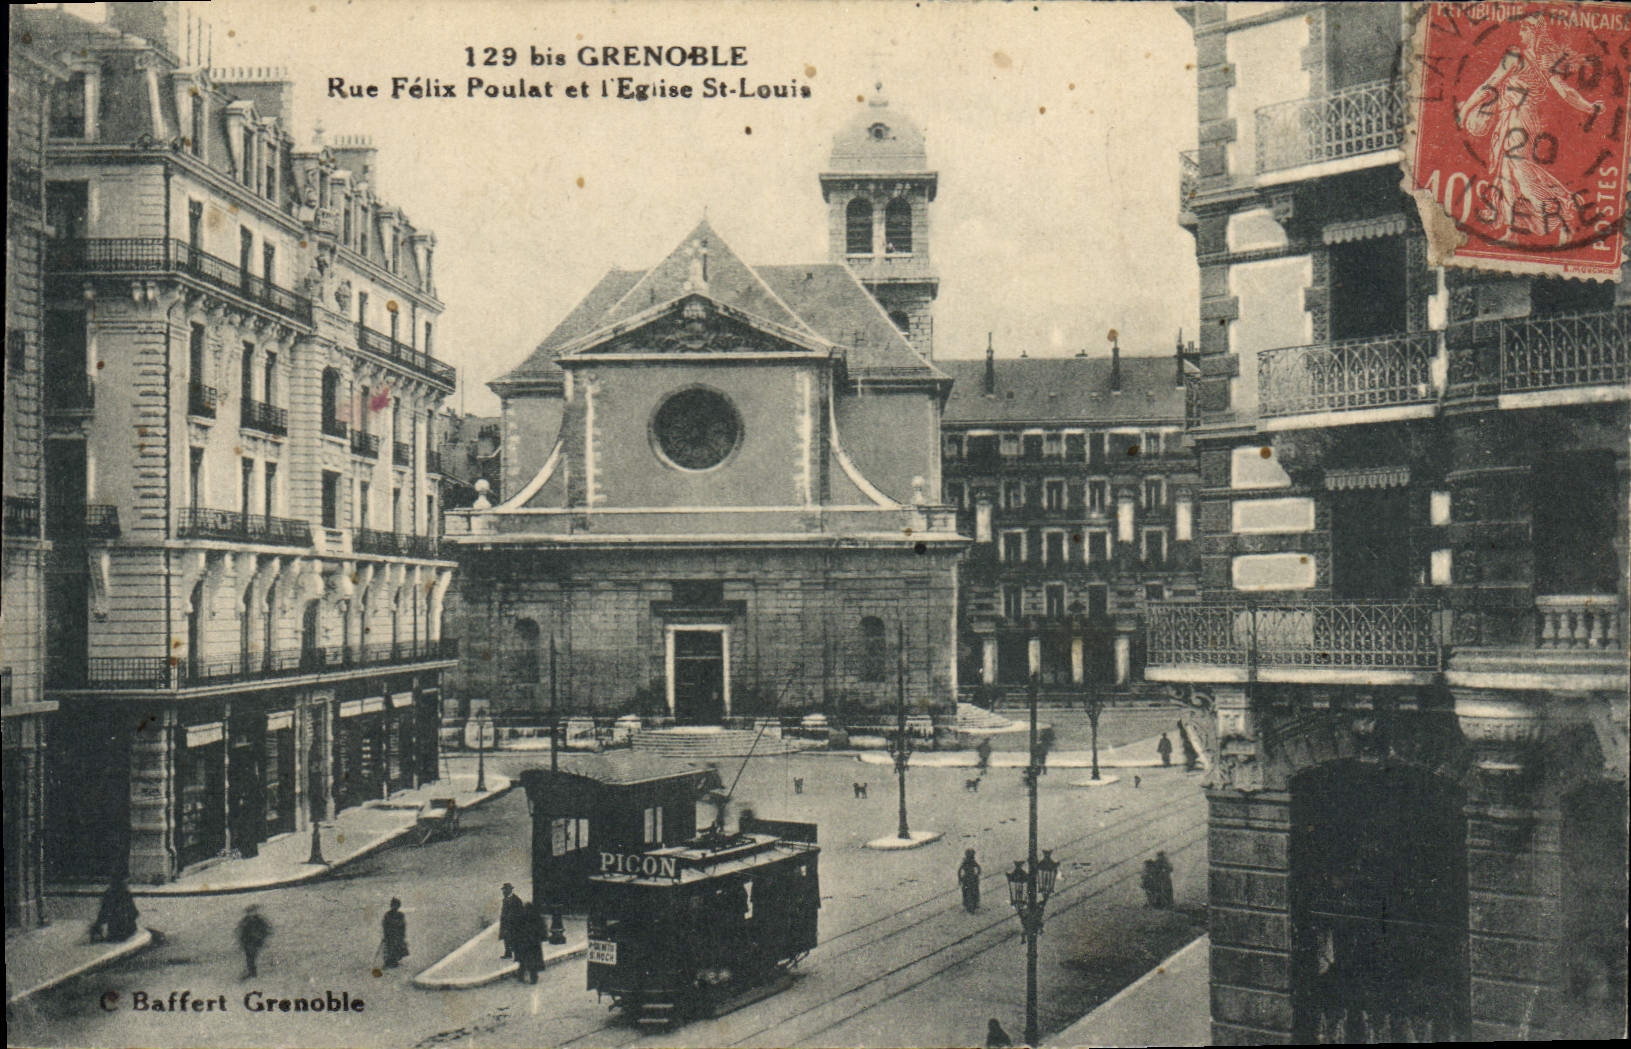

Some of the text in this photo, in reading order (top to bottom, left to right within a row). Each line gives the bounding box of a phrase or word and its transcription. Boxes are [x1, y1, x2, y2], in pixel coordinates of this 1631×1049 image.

[1503, 126, 1559, 166] 20
[1593, 165, 1620, 252] POSTES
[600, 852, 676, 878] PICON
